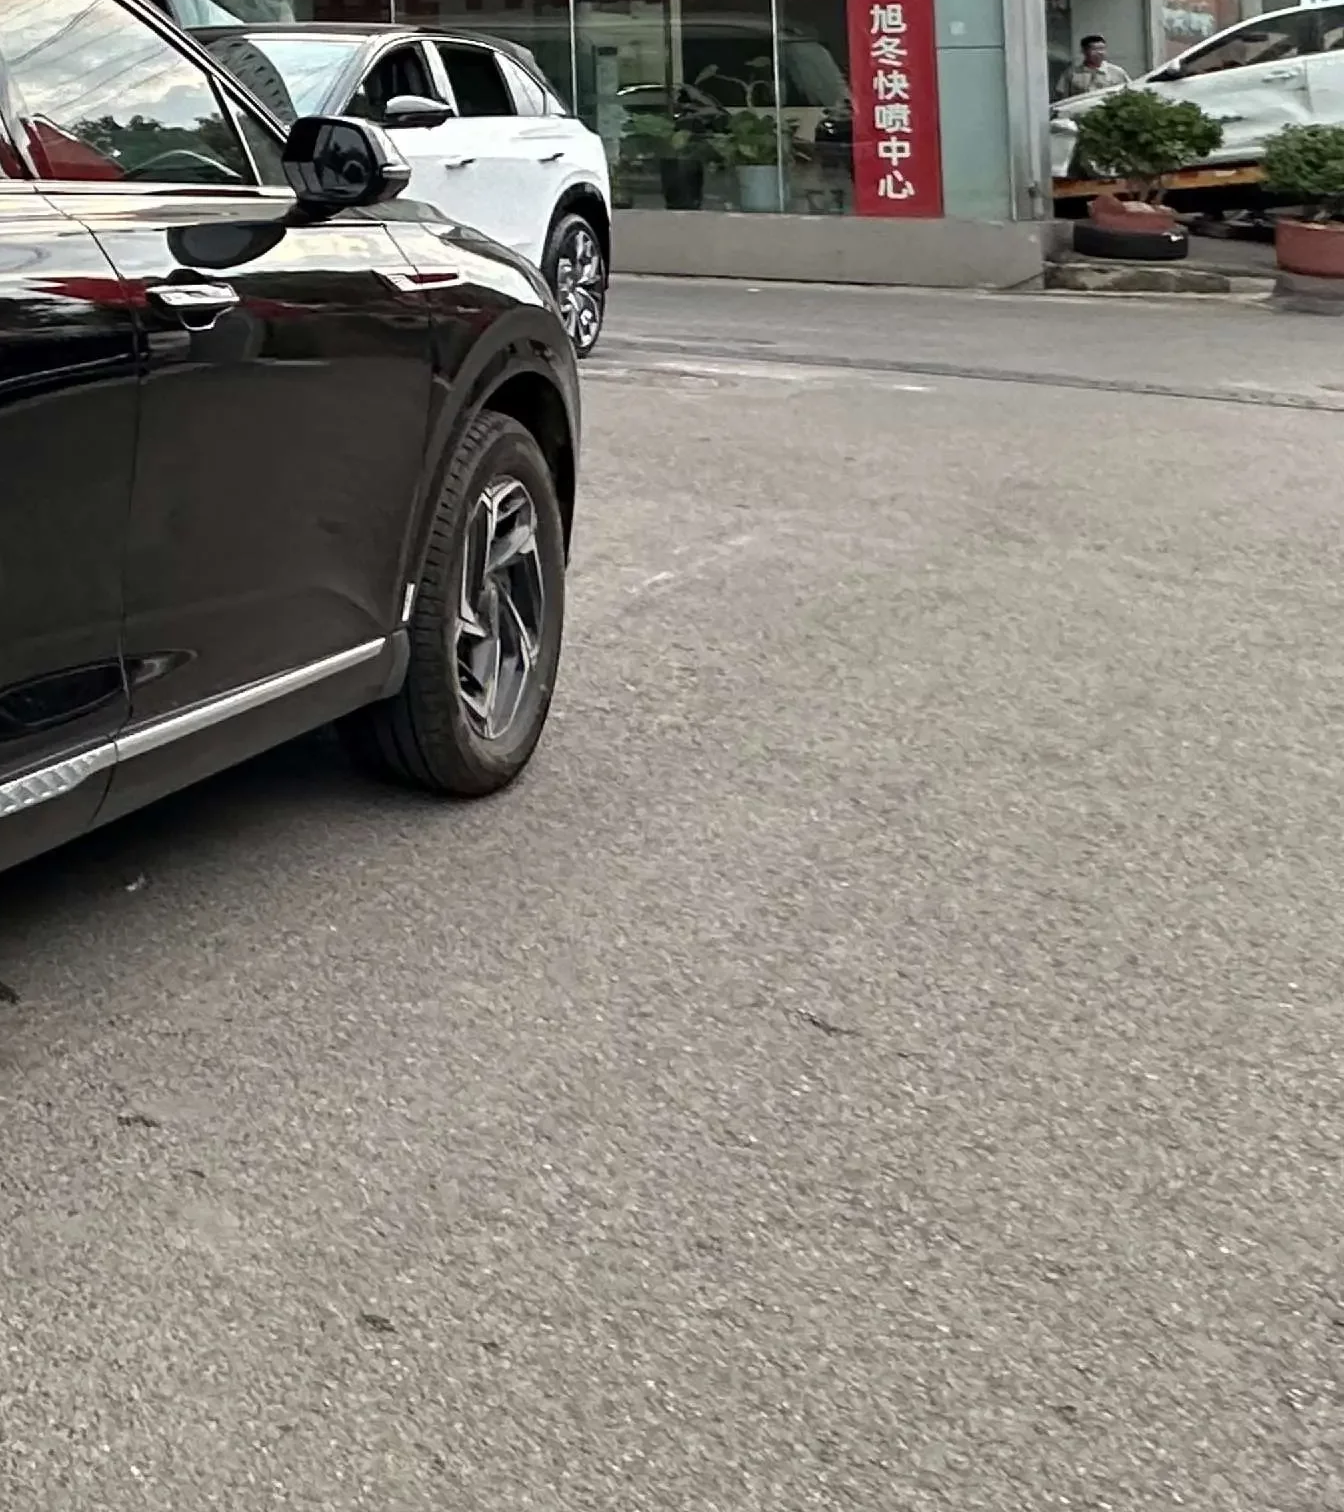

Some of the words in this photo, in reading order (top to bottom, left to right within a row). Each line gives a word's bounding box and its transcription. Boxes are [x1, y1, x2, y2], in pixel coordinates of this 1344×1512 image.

[869, 4, 915, 200] 旭冬快喷中心
